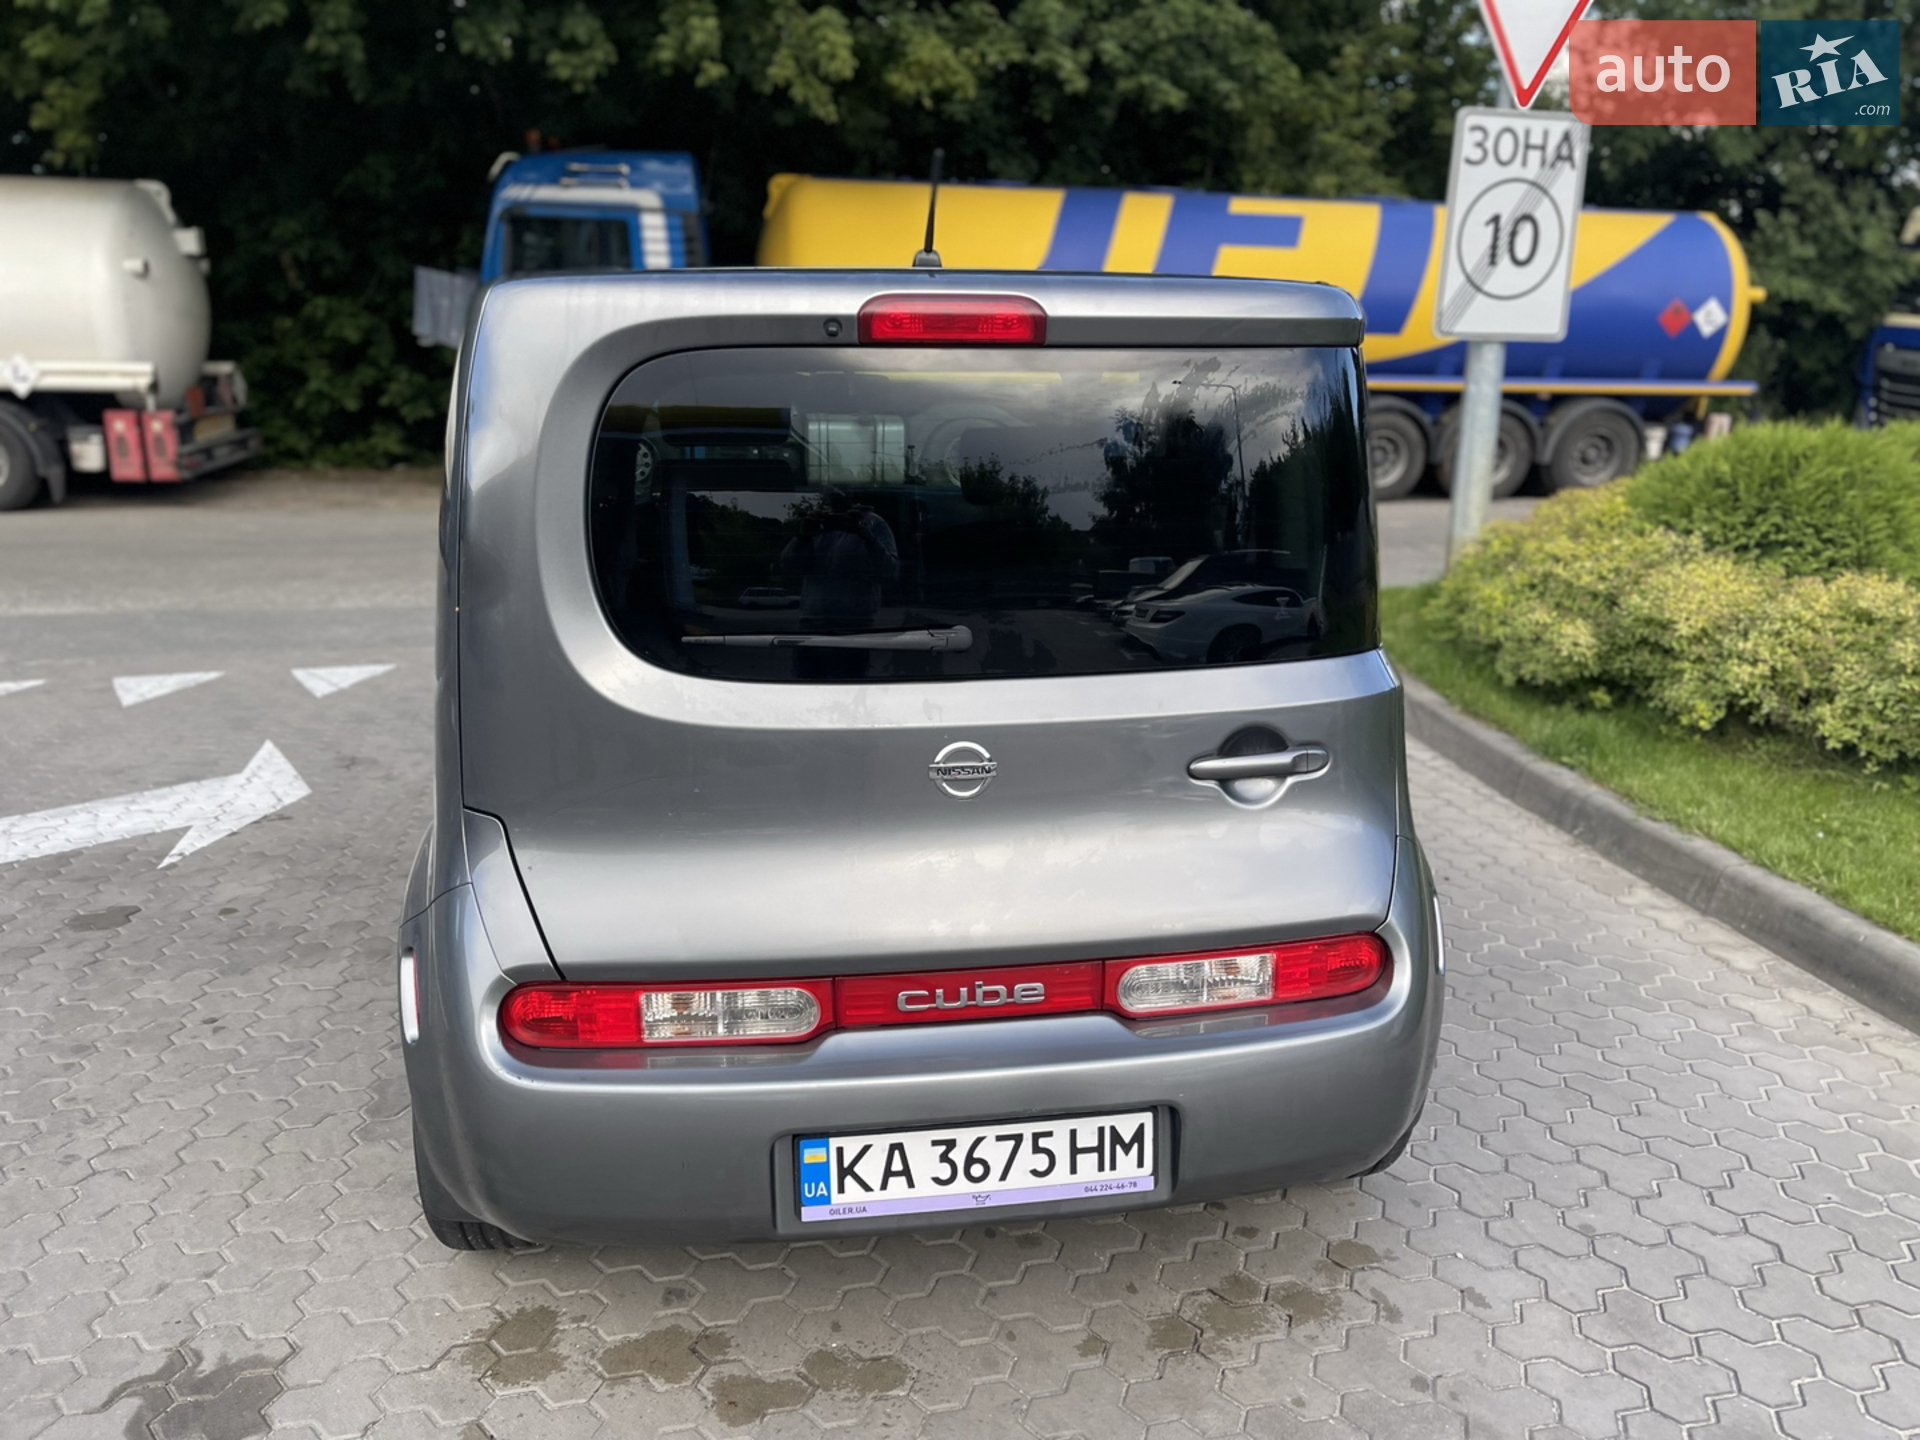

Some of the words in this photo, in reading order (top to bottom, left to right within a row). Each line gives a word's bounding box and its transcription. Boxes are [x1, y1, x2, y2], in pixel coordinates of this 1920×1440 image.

[1464, 126, 1576, 170] ЗОНА
[1484, 213, 1540, 267] 10
[936, 766, 993, 777] NISSAN
[897, 981, 1045, 1012] cube
[930, 1130, 1057, 1187] 3675
[804, 1181, 828, 1198] UA
[829, 1206, 868, 1216] OILER.UA
